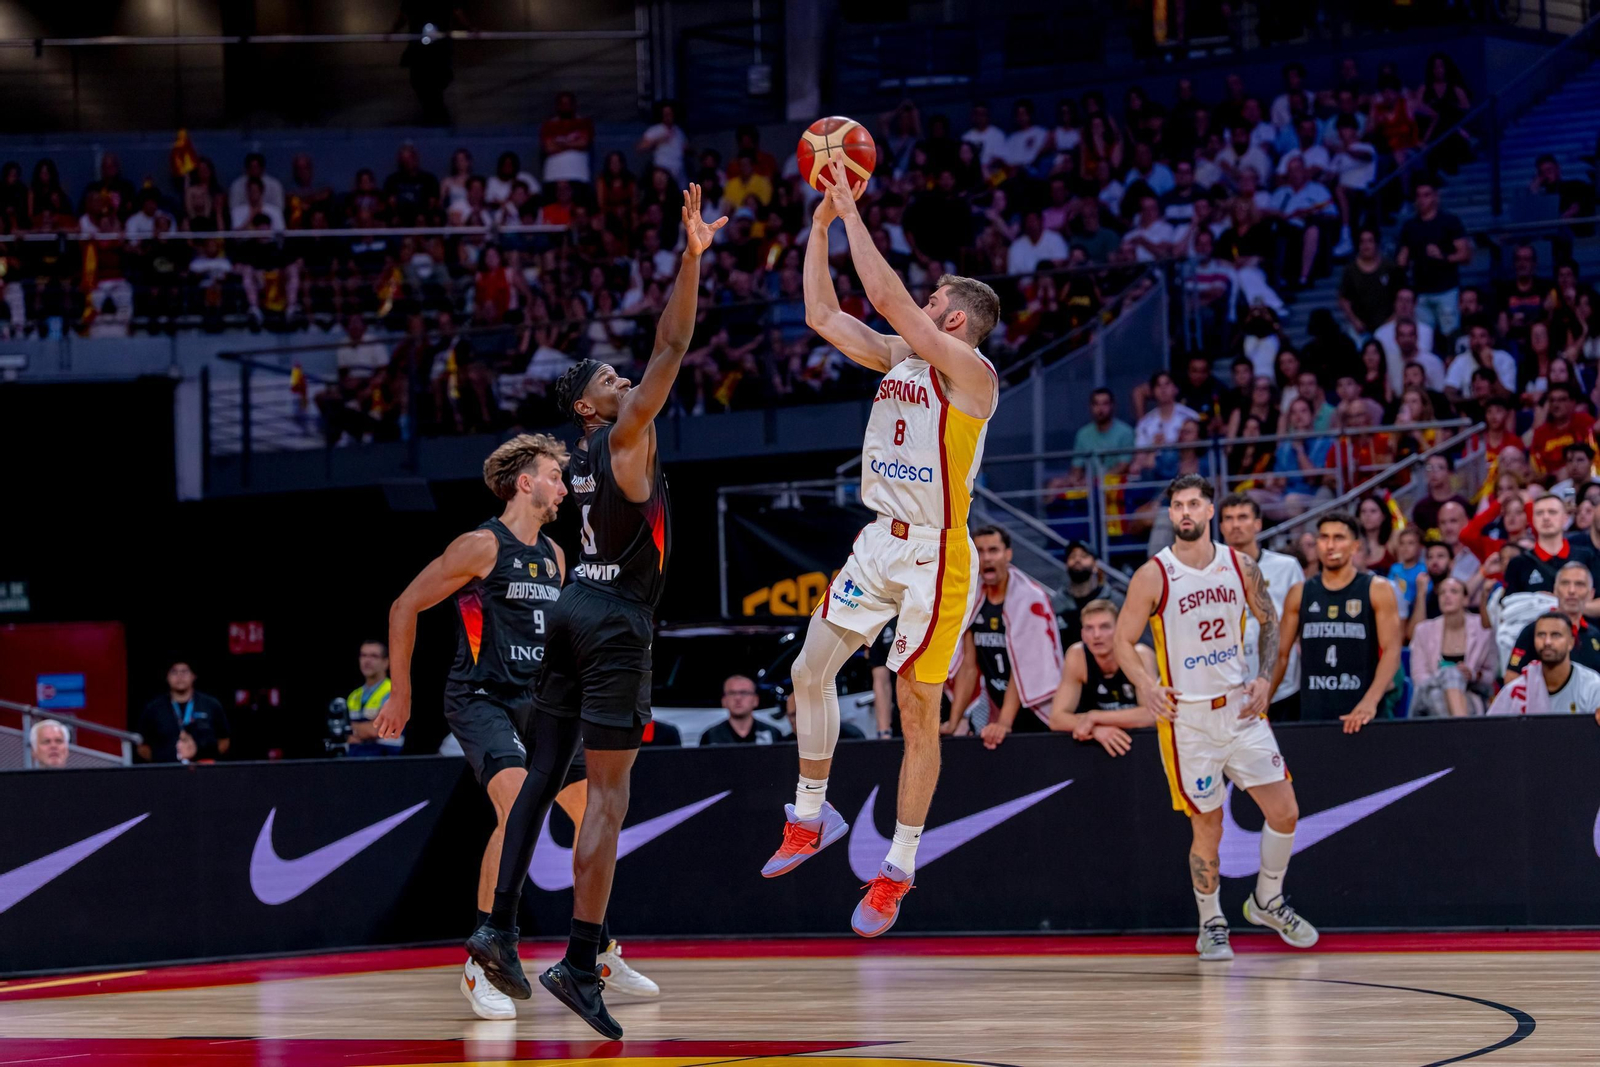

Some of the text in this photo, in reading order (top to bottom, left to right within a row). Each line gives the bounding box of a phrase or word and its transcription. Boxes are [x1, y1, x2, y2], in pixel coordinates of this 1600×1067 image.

[893, 419, 906, 446] 8
[1178, 585, 1238, 615] ESPAÑA
[533, 609, 546, 635] 9
[1198, 618, 1227, 642] 22
[509, 644, 545, 662] ING
[994, 653, 1006, 674] 1
[1325, 644, 1338, 668] 4
[1308, 675, 1338, 690] ING
